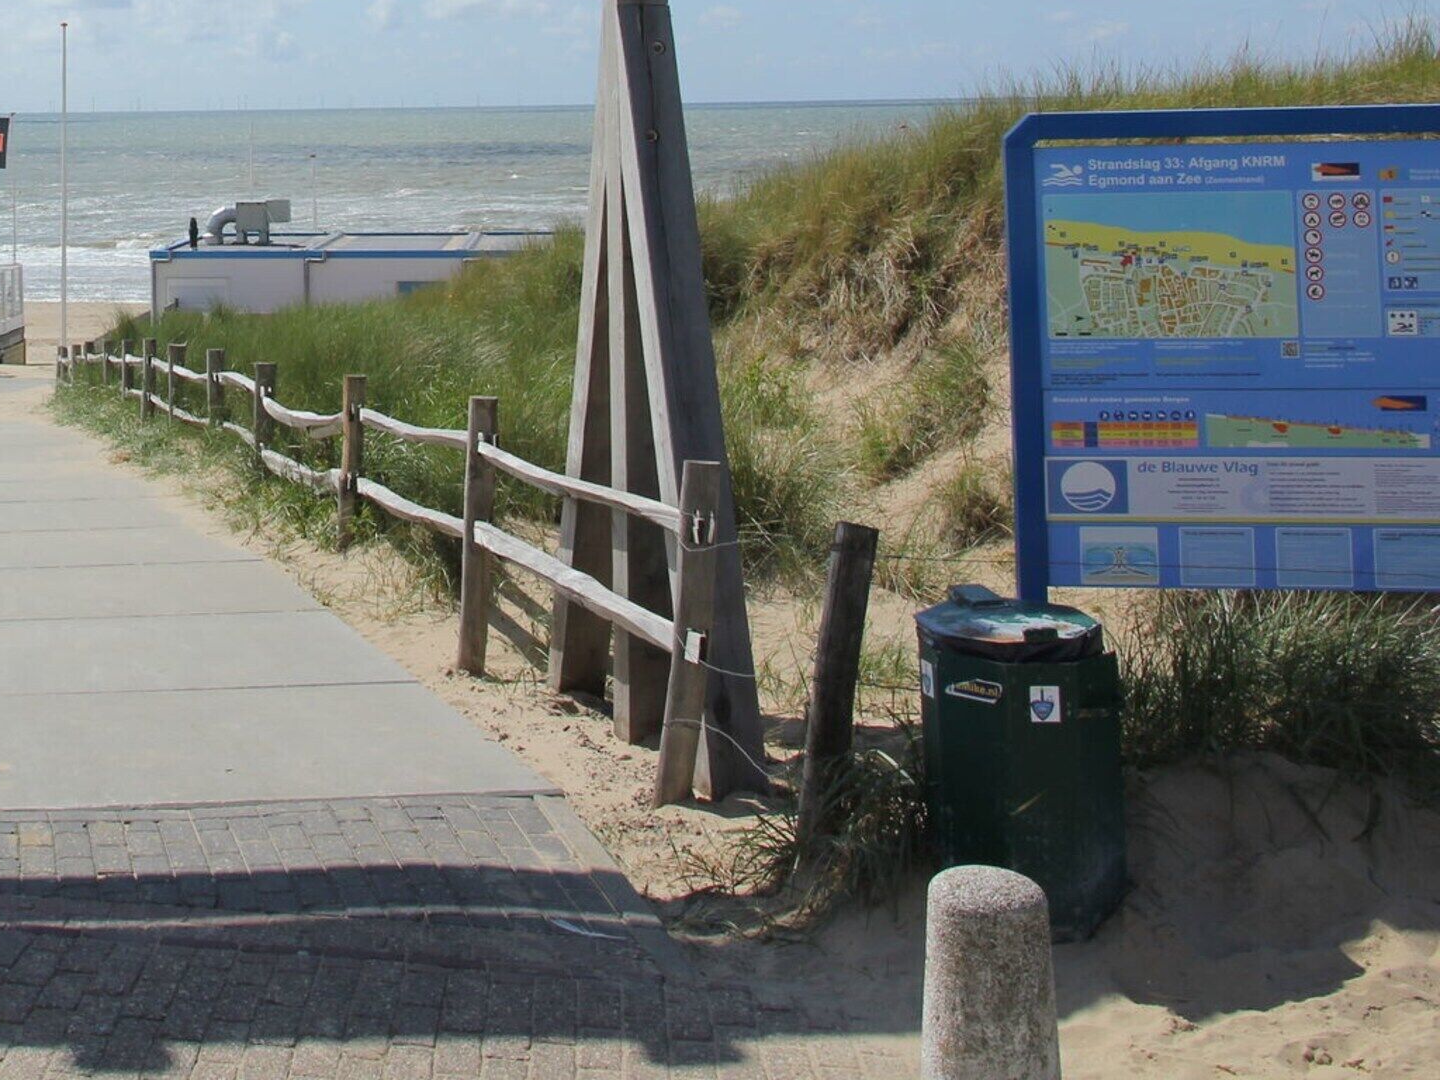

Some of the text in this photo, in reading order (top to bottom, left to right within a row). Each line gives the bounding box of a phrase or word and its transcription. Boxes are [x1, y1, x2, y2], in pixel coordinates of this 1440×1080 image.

[1088, 156, 1285, 171] Strandslag 33: Afgang KNRM
[1088, 174, 1145, 188] Egmond
[1149, 176, 1173, 185] aan
[1177, 173, 1202, 185] Zee
[1138, 461, 1157, 474] de
[1162, 461, 1219, 474] Blauwe
[1223, 461, 1259, 476] Vlag
